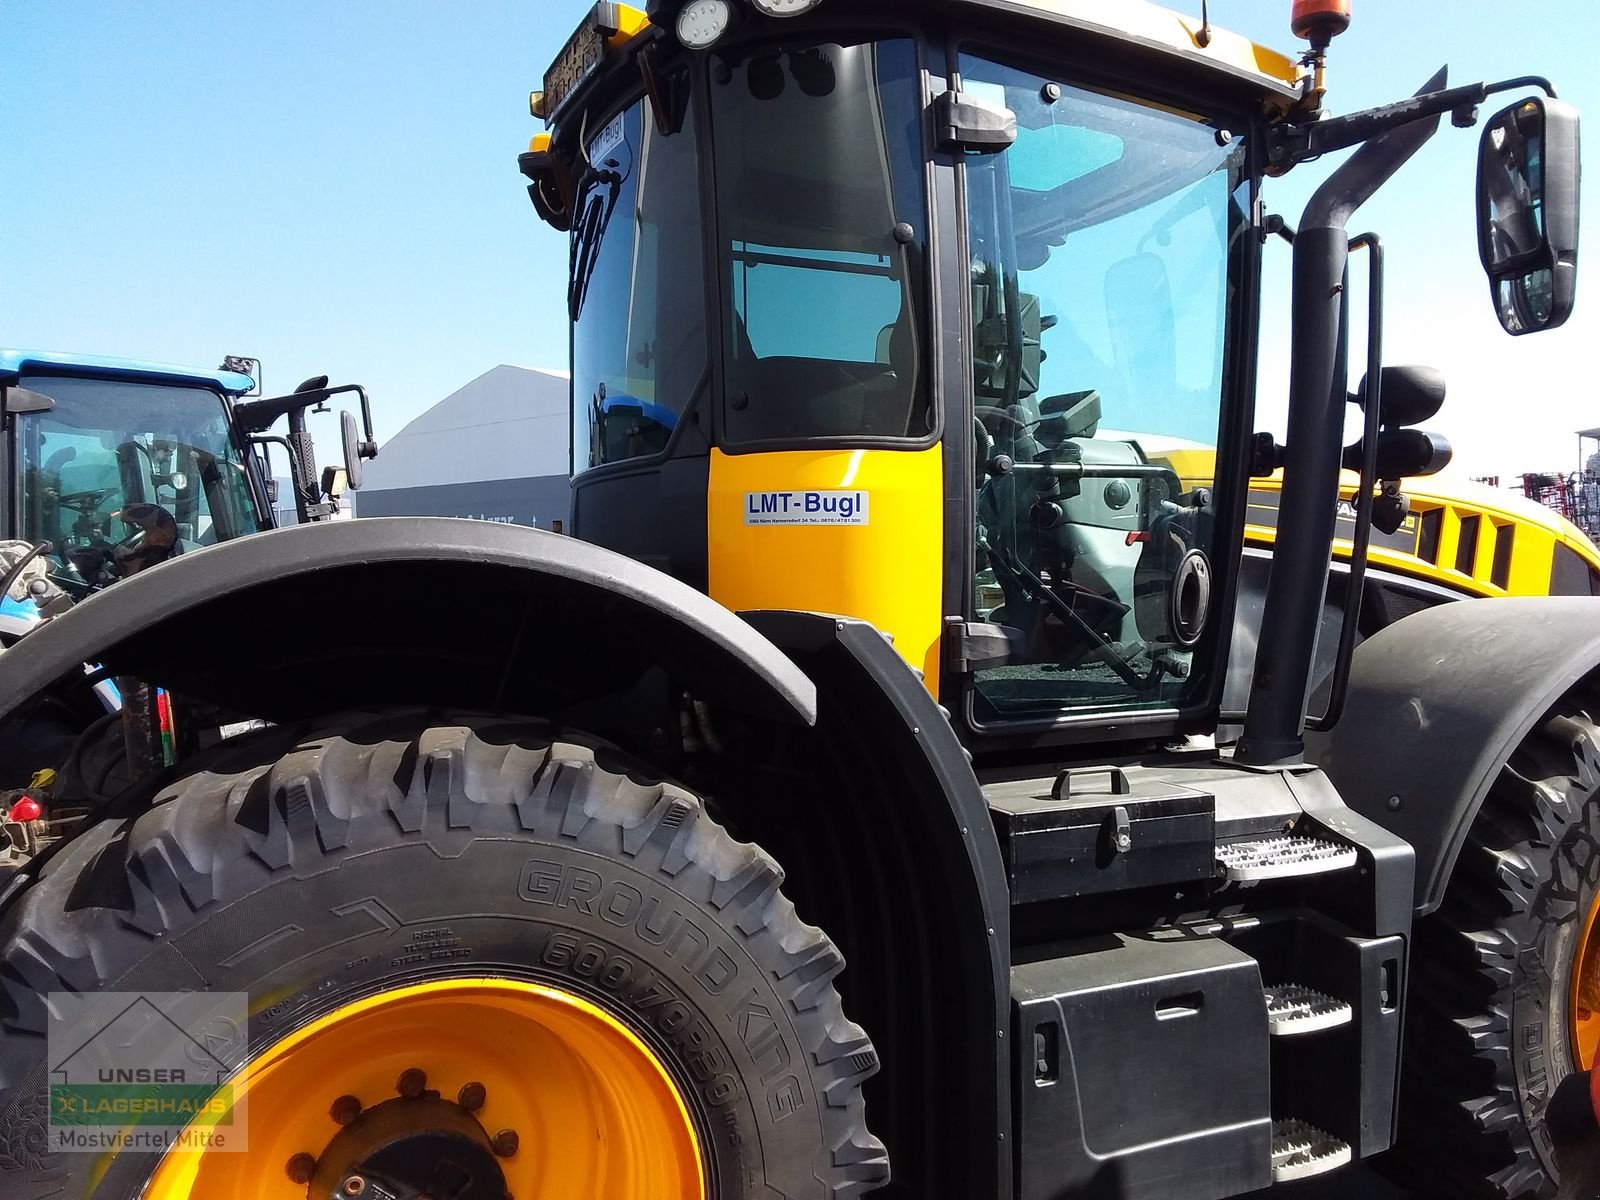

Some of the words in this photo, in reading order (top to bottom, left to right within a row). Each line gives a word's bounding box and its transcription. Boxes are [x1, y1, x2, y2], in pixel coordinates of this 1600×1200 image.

[749, 492, 861, 518] LMT-Bugl
[516, 858, 739, 996] GROUND
[725, 986, 805, 1124] KING
